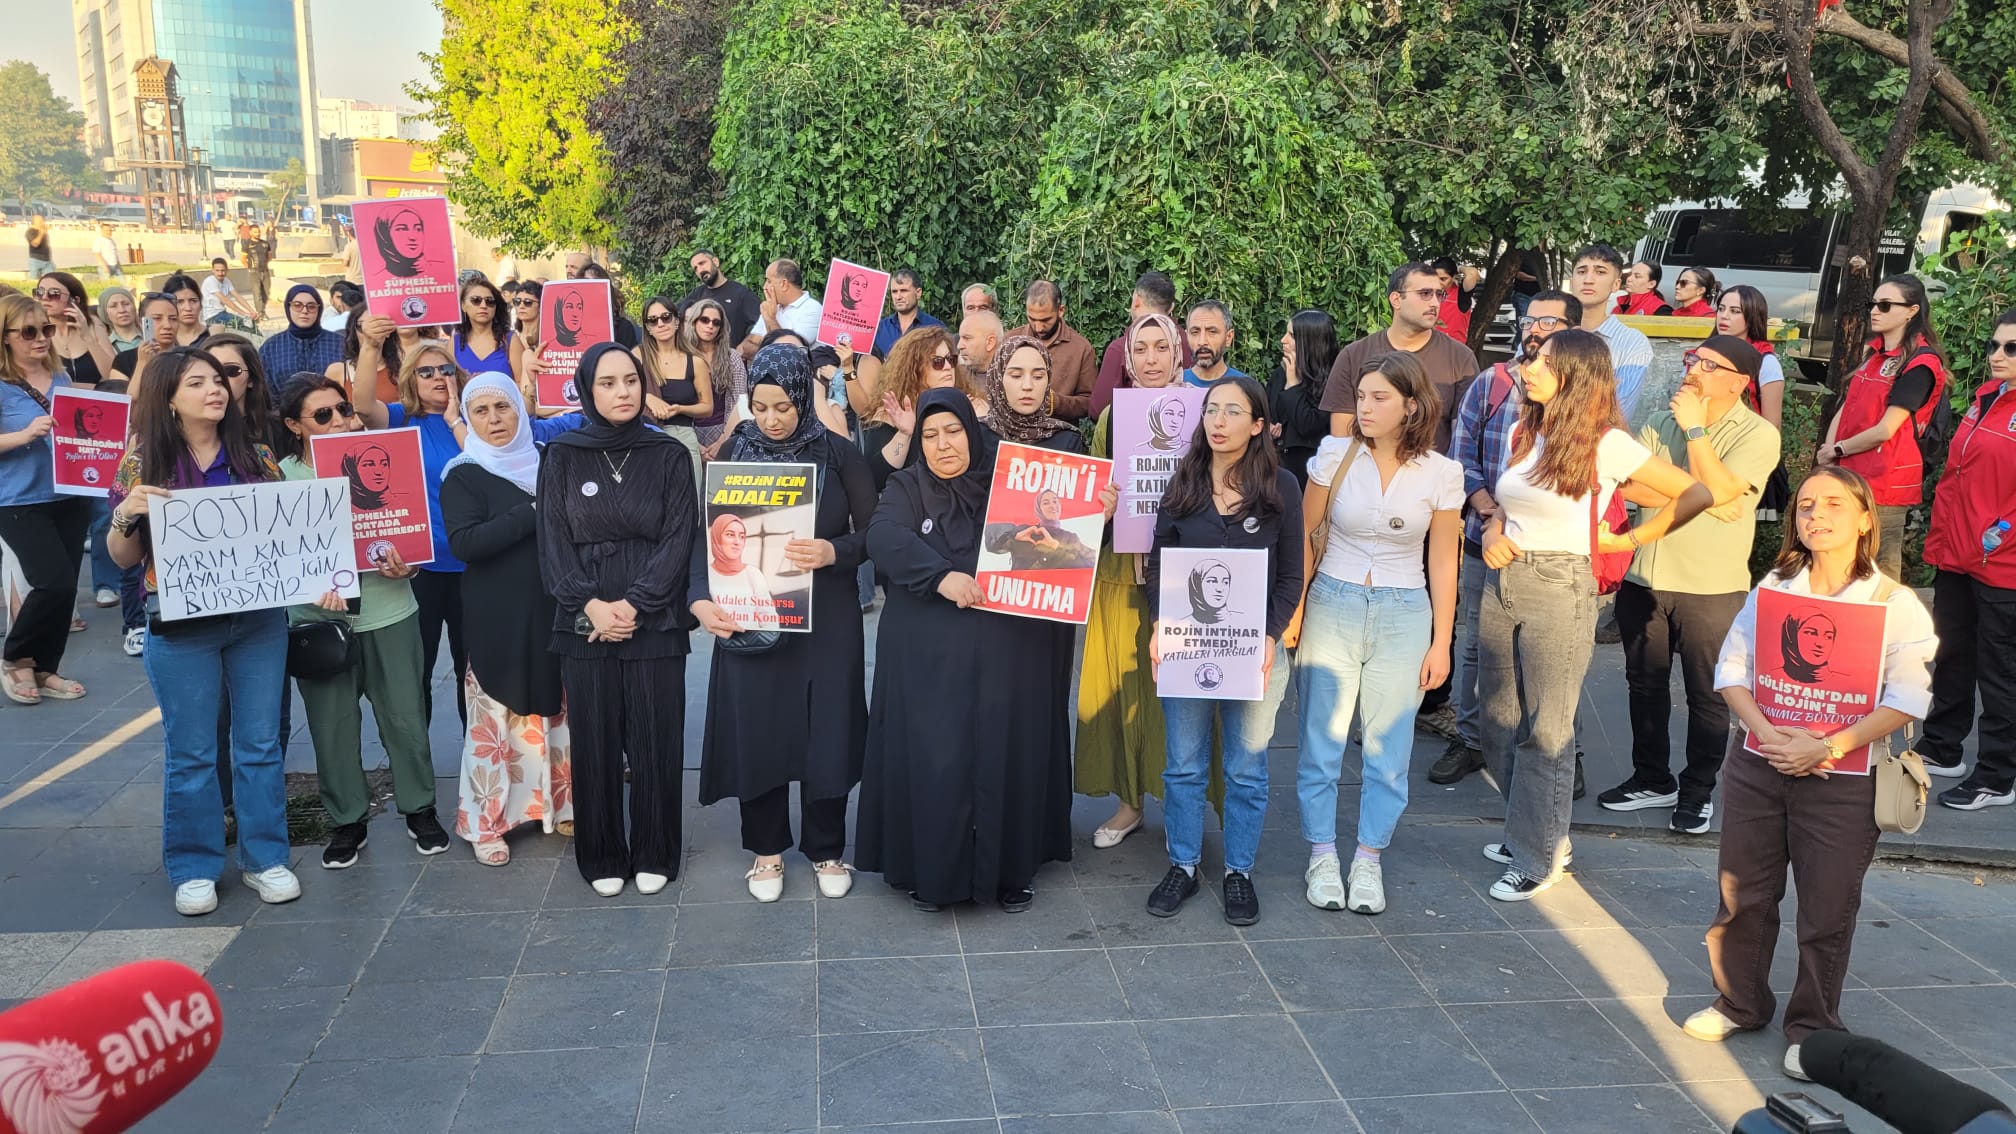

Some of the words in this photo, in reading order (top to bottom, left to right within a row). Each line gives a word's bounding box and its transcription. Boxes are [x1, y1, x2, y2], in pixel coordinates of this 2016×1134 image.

[369, 287, 403, 298] KADIN
[551, 357, 579, 367] ÖLÜML
[1006, 457, 1097, 502] ROJİN'İ
[1136, 475, 1168, 493] KATİL
[712, 489, 802, 506] ADALET
[1136, 500, 1159, 514] NER
[161, 484, 344, 545] ROJİNİN
[352, 508, 409, 522] ÜPHELİLER
[354, 518, 401, 531] ORTADA
[378, 523, 427, 537] NEREDE?
[163, 547, 238, 577] YARIM
[254, 526, 338, 563] KALAN
[987, 574, 1075, 615] UNUTMA
[715, 595, 748, 607] Adalet
[749, 596, 795, 609] Susarsa
[729, 611, 750, 622] dan
[752, 612, 804, 626] Konuşur
[1164, 624, 1202, 636] ROJİN
[1205, 624, 1260, 638] İNTİHAR
[1184, 637, 1238, 649] ETMEDİ!
[1162, 647, 1211, 661] KATİLLERİ
[1758, 674, 1868, 705] GÜLİSTAN'DAN
[1774, 693, 1837, 714] ROJİN'E
[98, 991, 215, 1076] anka
